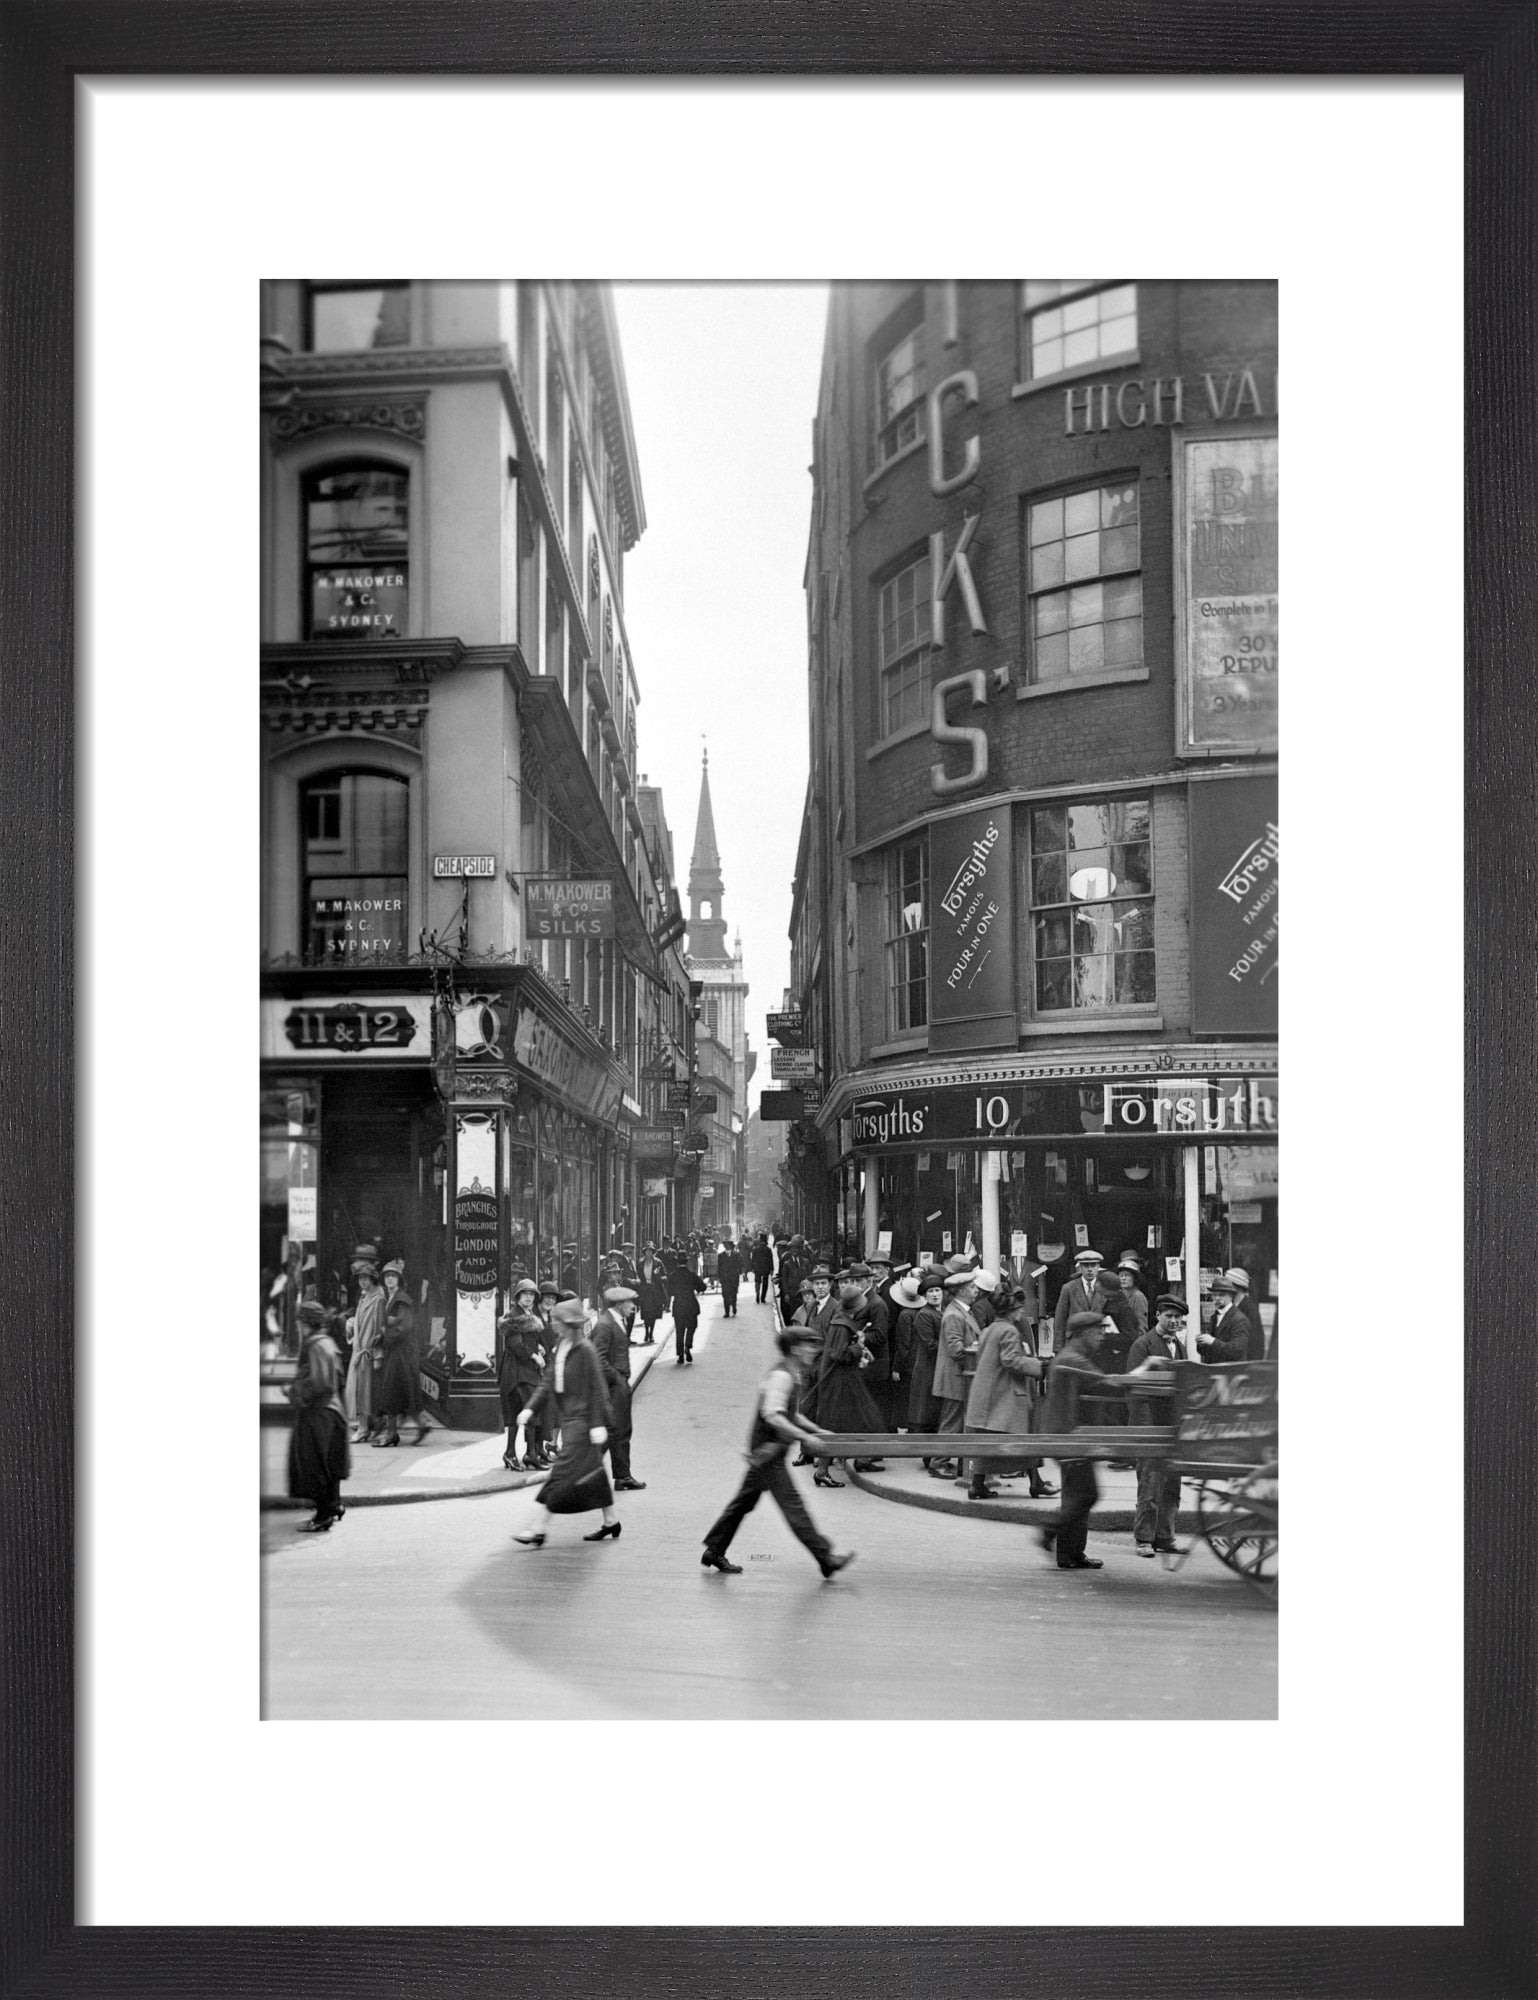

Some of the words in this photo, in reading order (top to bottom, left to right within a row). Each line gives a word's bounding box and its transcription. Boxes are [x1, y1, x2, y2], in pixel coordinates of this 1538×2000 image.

[1064, 376, 1184, 437] HIGH
[1200, 369, 1278, 422] VA
[335, 575, 404, 588] MAKOWER
[345, 594, 354, 606] &
[1201, 600, 1252, 619] Complete
[328, 614, 394, 627] SYDNEY
[1240, 636, 1265, 653] 30
[437, 857, 493, 874] CHEAPSIDE
[545, 884, 612, 901] MAKOWER
[333, 899, 402, 912] MAKOWER
[552, 903, 562, 917] &
[956, 891, 985, 936] FAMOUS
[345, 920, 354, 931] &
[539, 920, 601, 934] SILKS
[328, 939, 392, 951] SYDNEY
[947, 949, 974, 989] FOUR
[970, 936, 981, 950] IN
[977, 901, 1000, 935] ONE
[1228, 939, 1268, 983] FOUR
[777, 1049, 810, 1057] FRENCH
[852, 1098, 929, 1143] Forsyths'
[976, 1096, 1009, 1129] 10
[1102, 1080, 1276, 1132] Forsyth
[455, 1200, 498, 1218] BRANCHES
[454, 1219, 498, 1231] THROUGHOUT
[455, 1235, 498, 1251] LONDON
[465, 1257, 486, 1266] AND
[455, 1259, 498, 1286] PROVINCES
